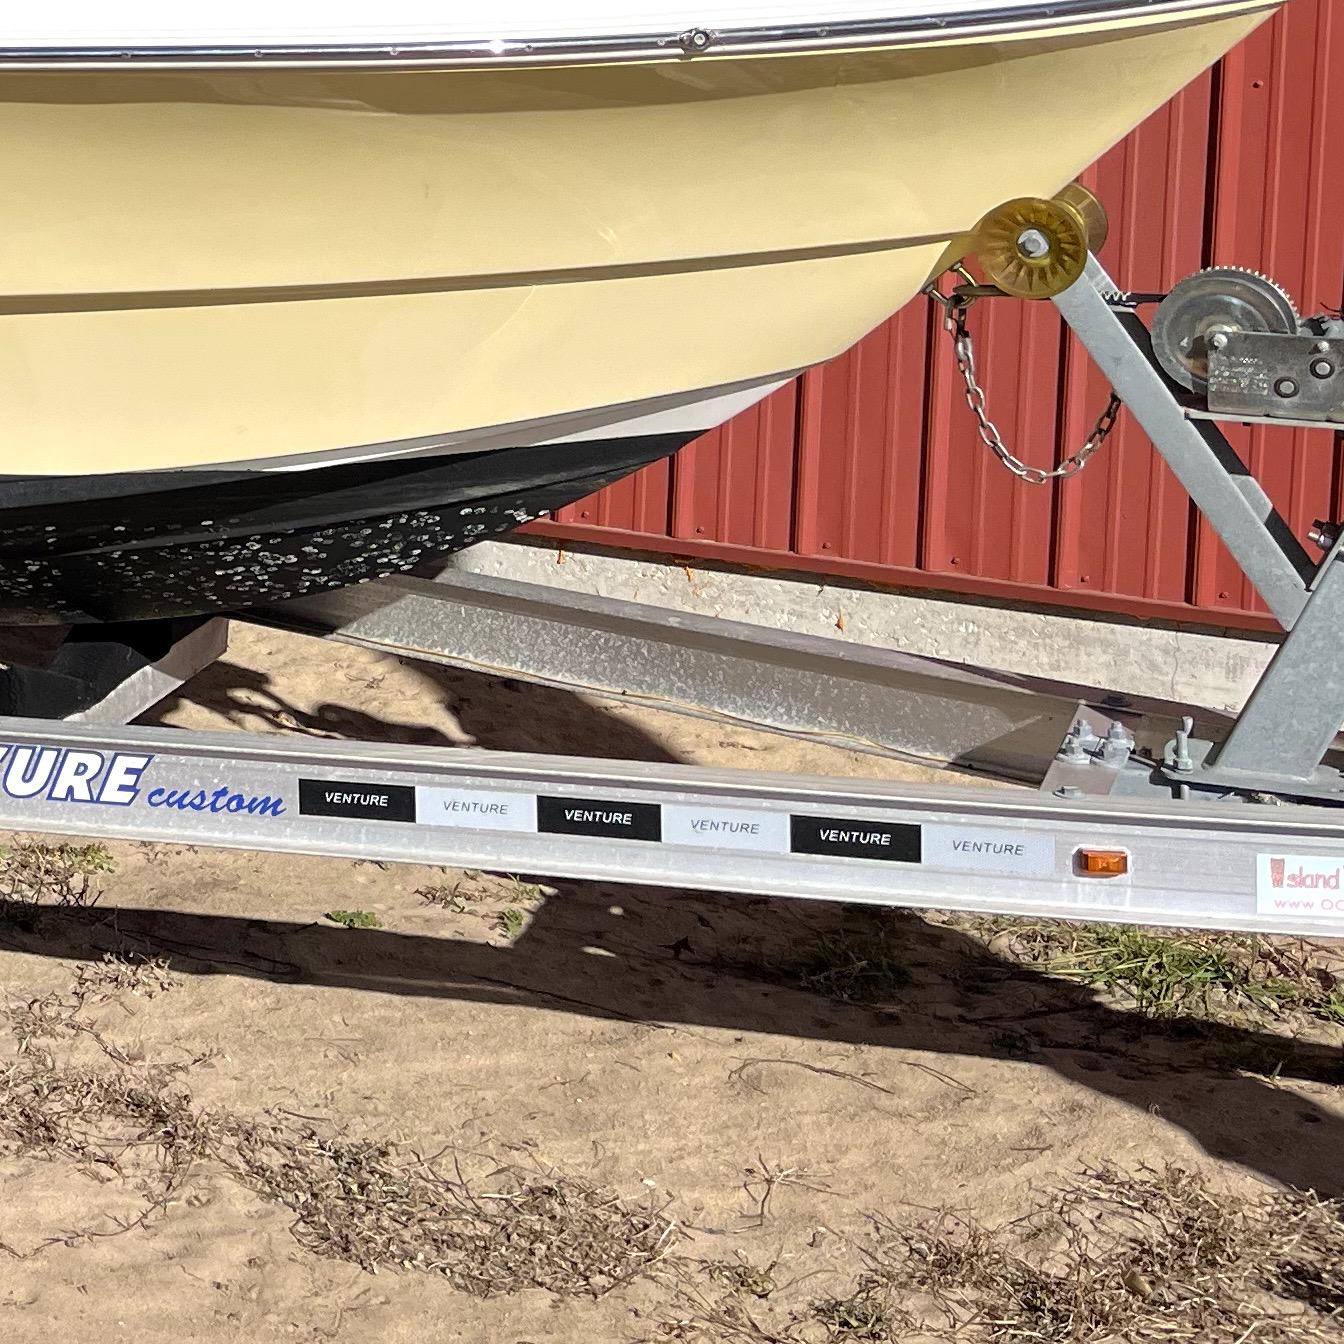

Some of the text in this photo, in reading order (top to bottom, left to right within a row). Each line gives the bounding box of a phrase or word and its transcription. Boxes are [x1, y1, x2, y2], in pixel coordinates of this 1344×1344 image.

[146, 785, 287, 817] custom
[324, 791, 1026, 856] VENTURE VENTURE VENTURE VENTURE VENTURE VENTURE
